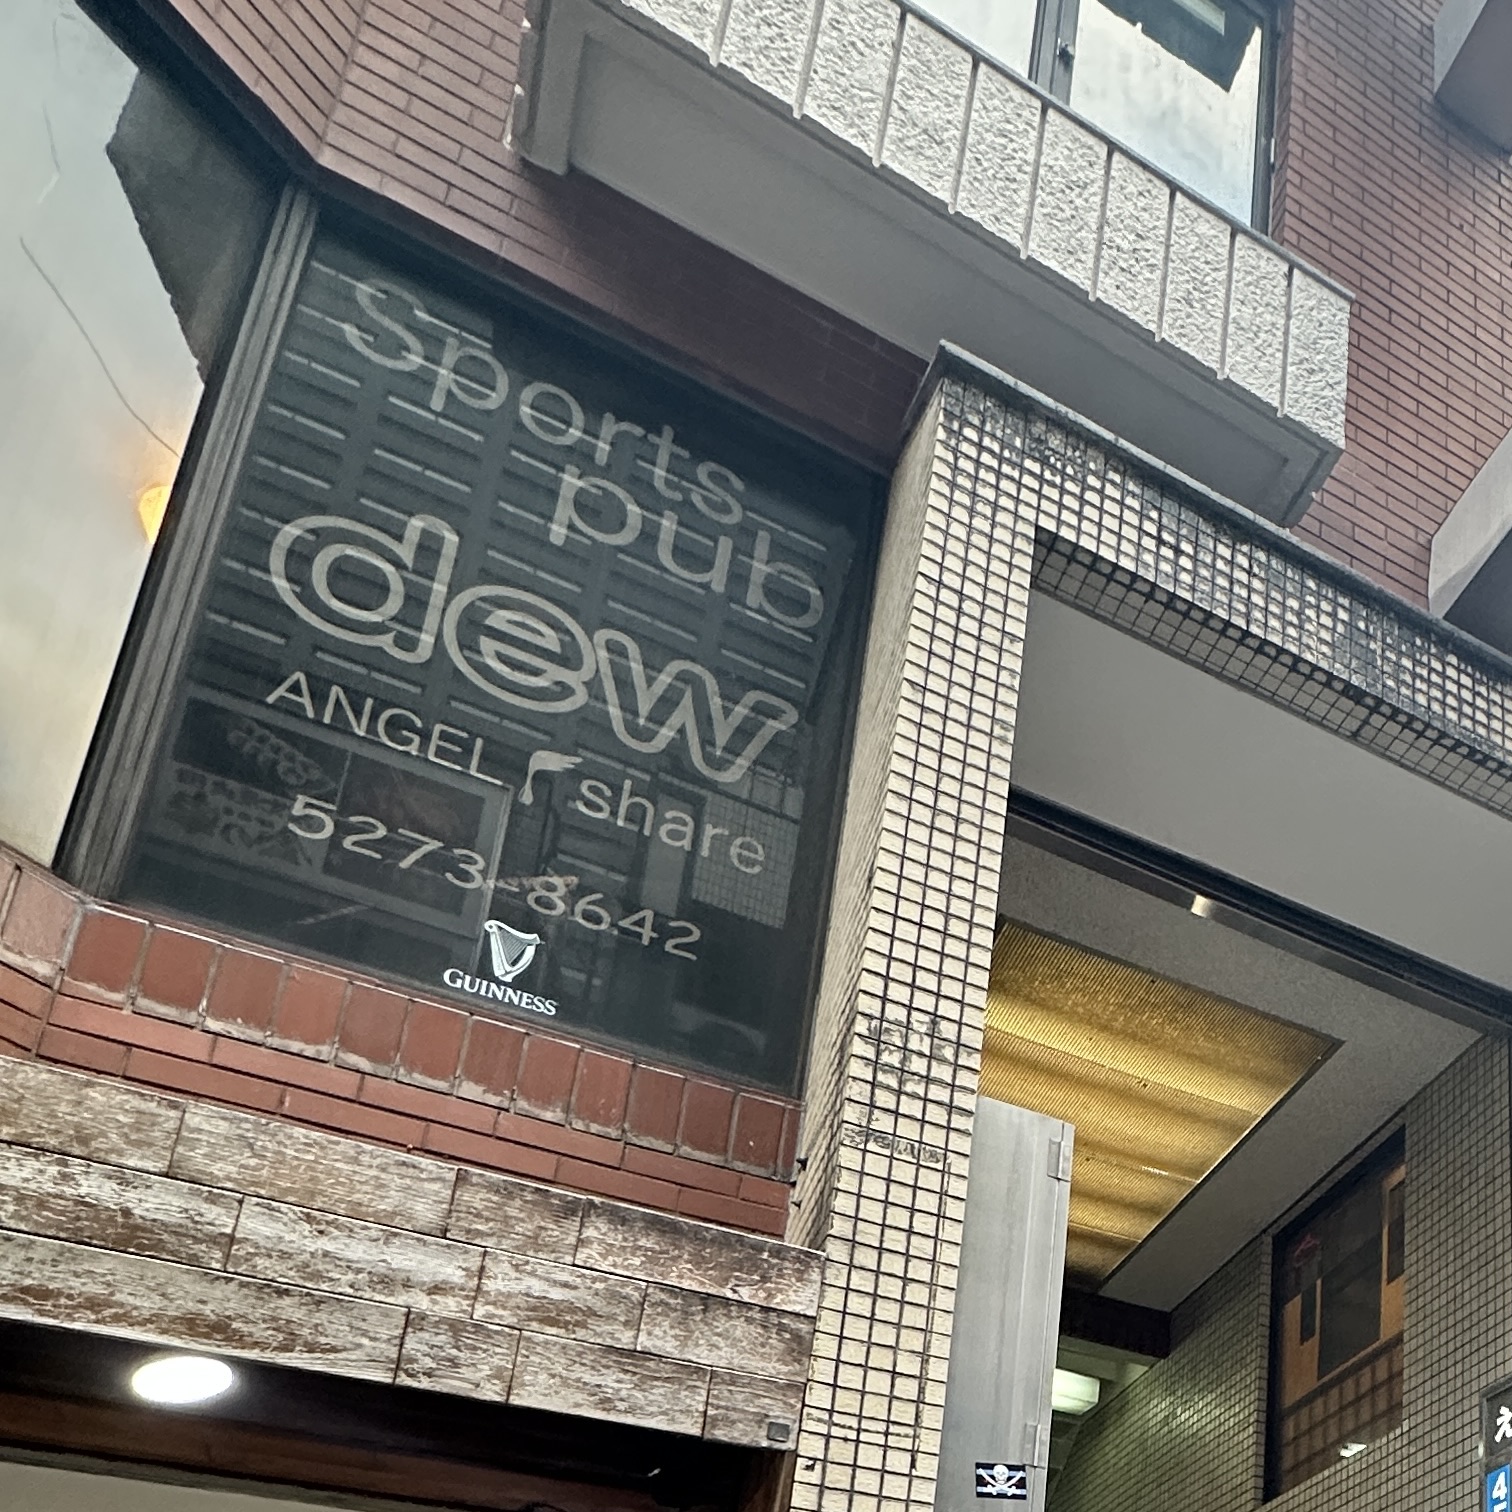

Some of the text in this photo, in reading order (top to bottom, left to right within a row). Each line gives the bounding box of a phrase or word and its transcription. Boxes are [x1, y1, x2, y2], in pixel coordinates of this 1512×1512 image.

[341, 276, 746, 527] Sports
[548, 463, 825, 630] pub
[270, 514, 799, 782] dew
[266, 670, 766, 875] ANGEL share
[286, 793, 703, 962] 5273-8642
[443, 967, 556, 1017] GUINNESS
